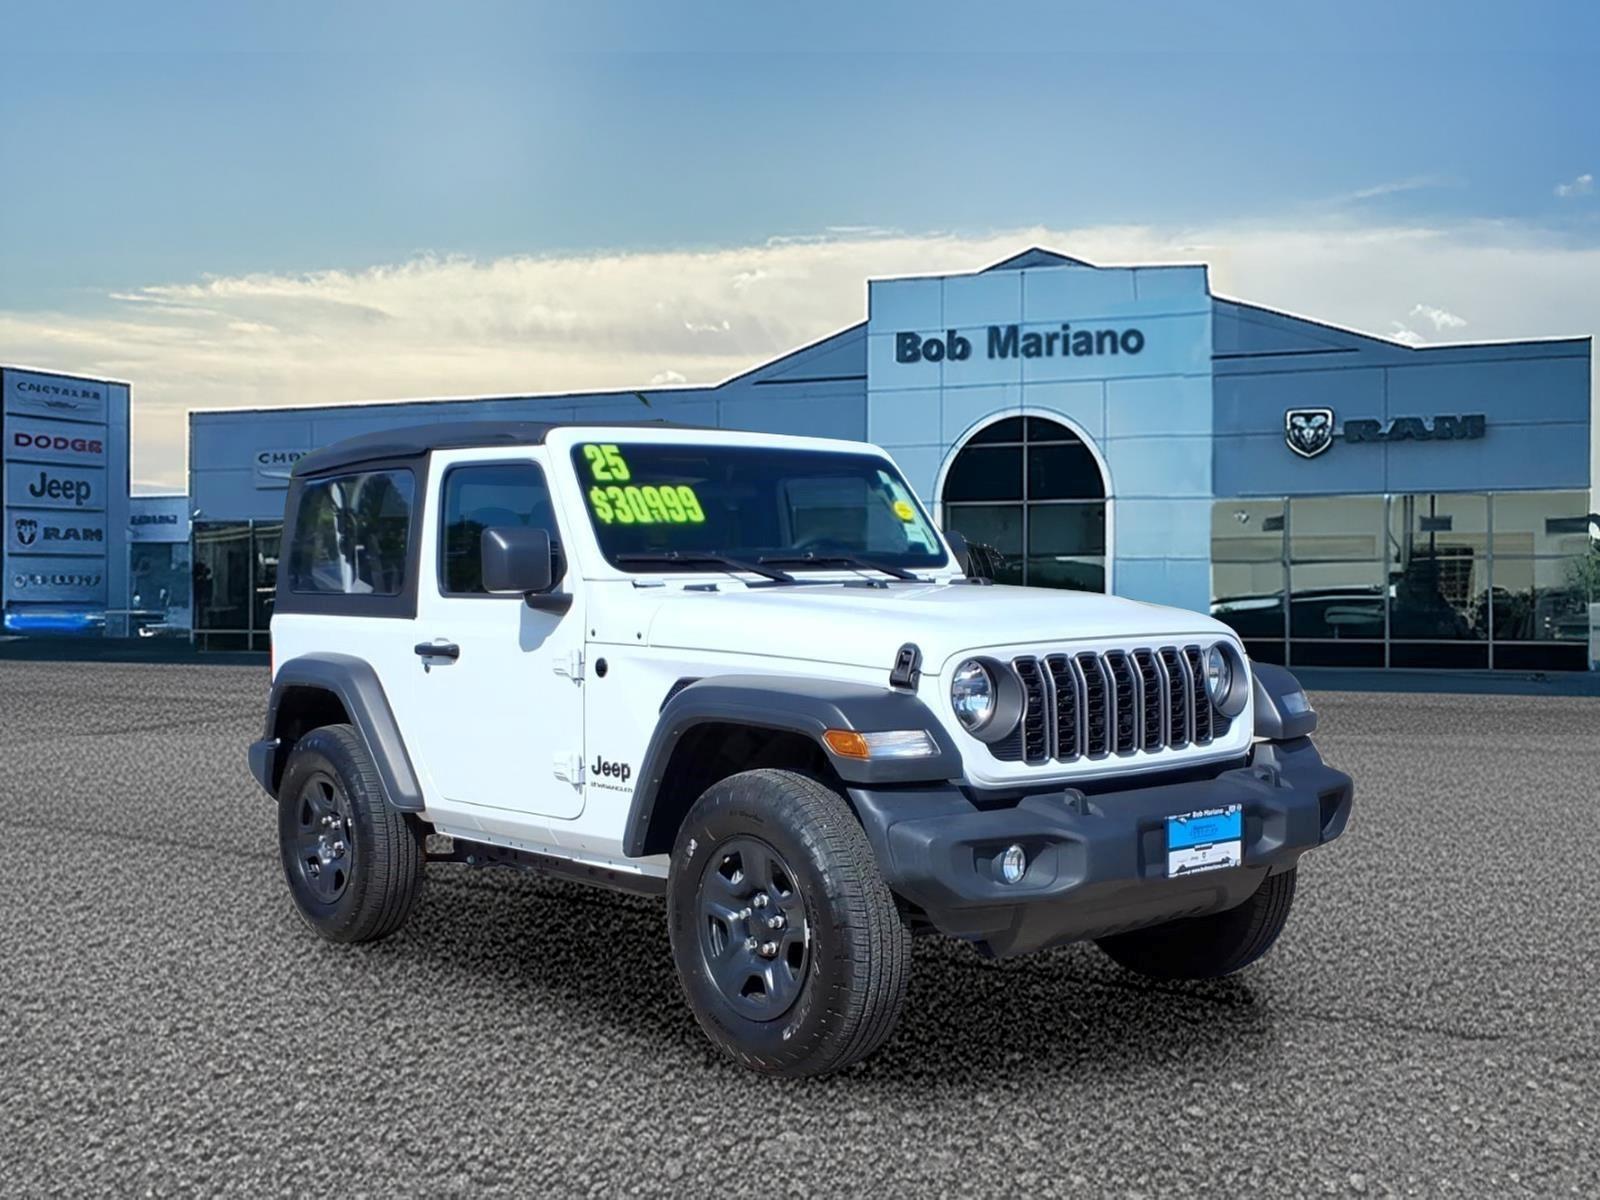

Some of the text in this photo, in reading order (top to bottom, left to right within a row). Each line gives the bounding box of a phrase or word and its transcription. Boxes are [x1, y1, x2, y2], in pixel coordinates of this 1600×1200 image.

[896, 324, 1145, 363] Bob Mariano
[1344, 414, 1486, 443] RAM
[583, 444, 630, 480] 25
[29, 472, 91, 506] Jeep
[43, 527, 103, 541] RAM
[591, 754, 631, 782] Jeep
